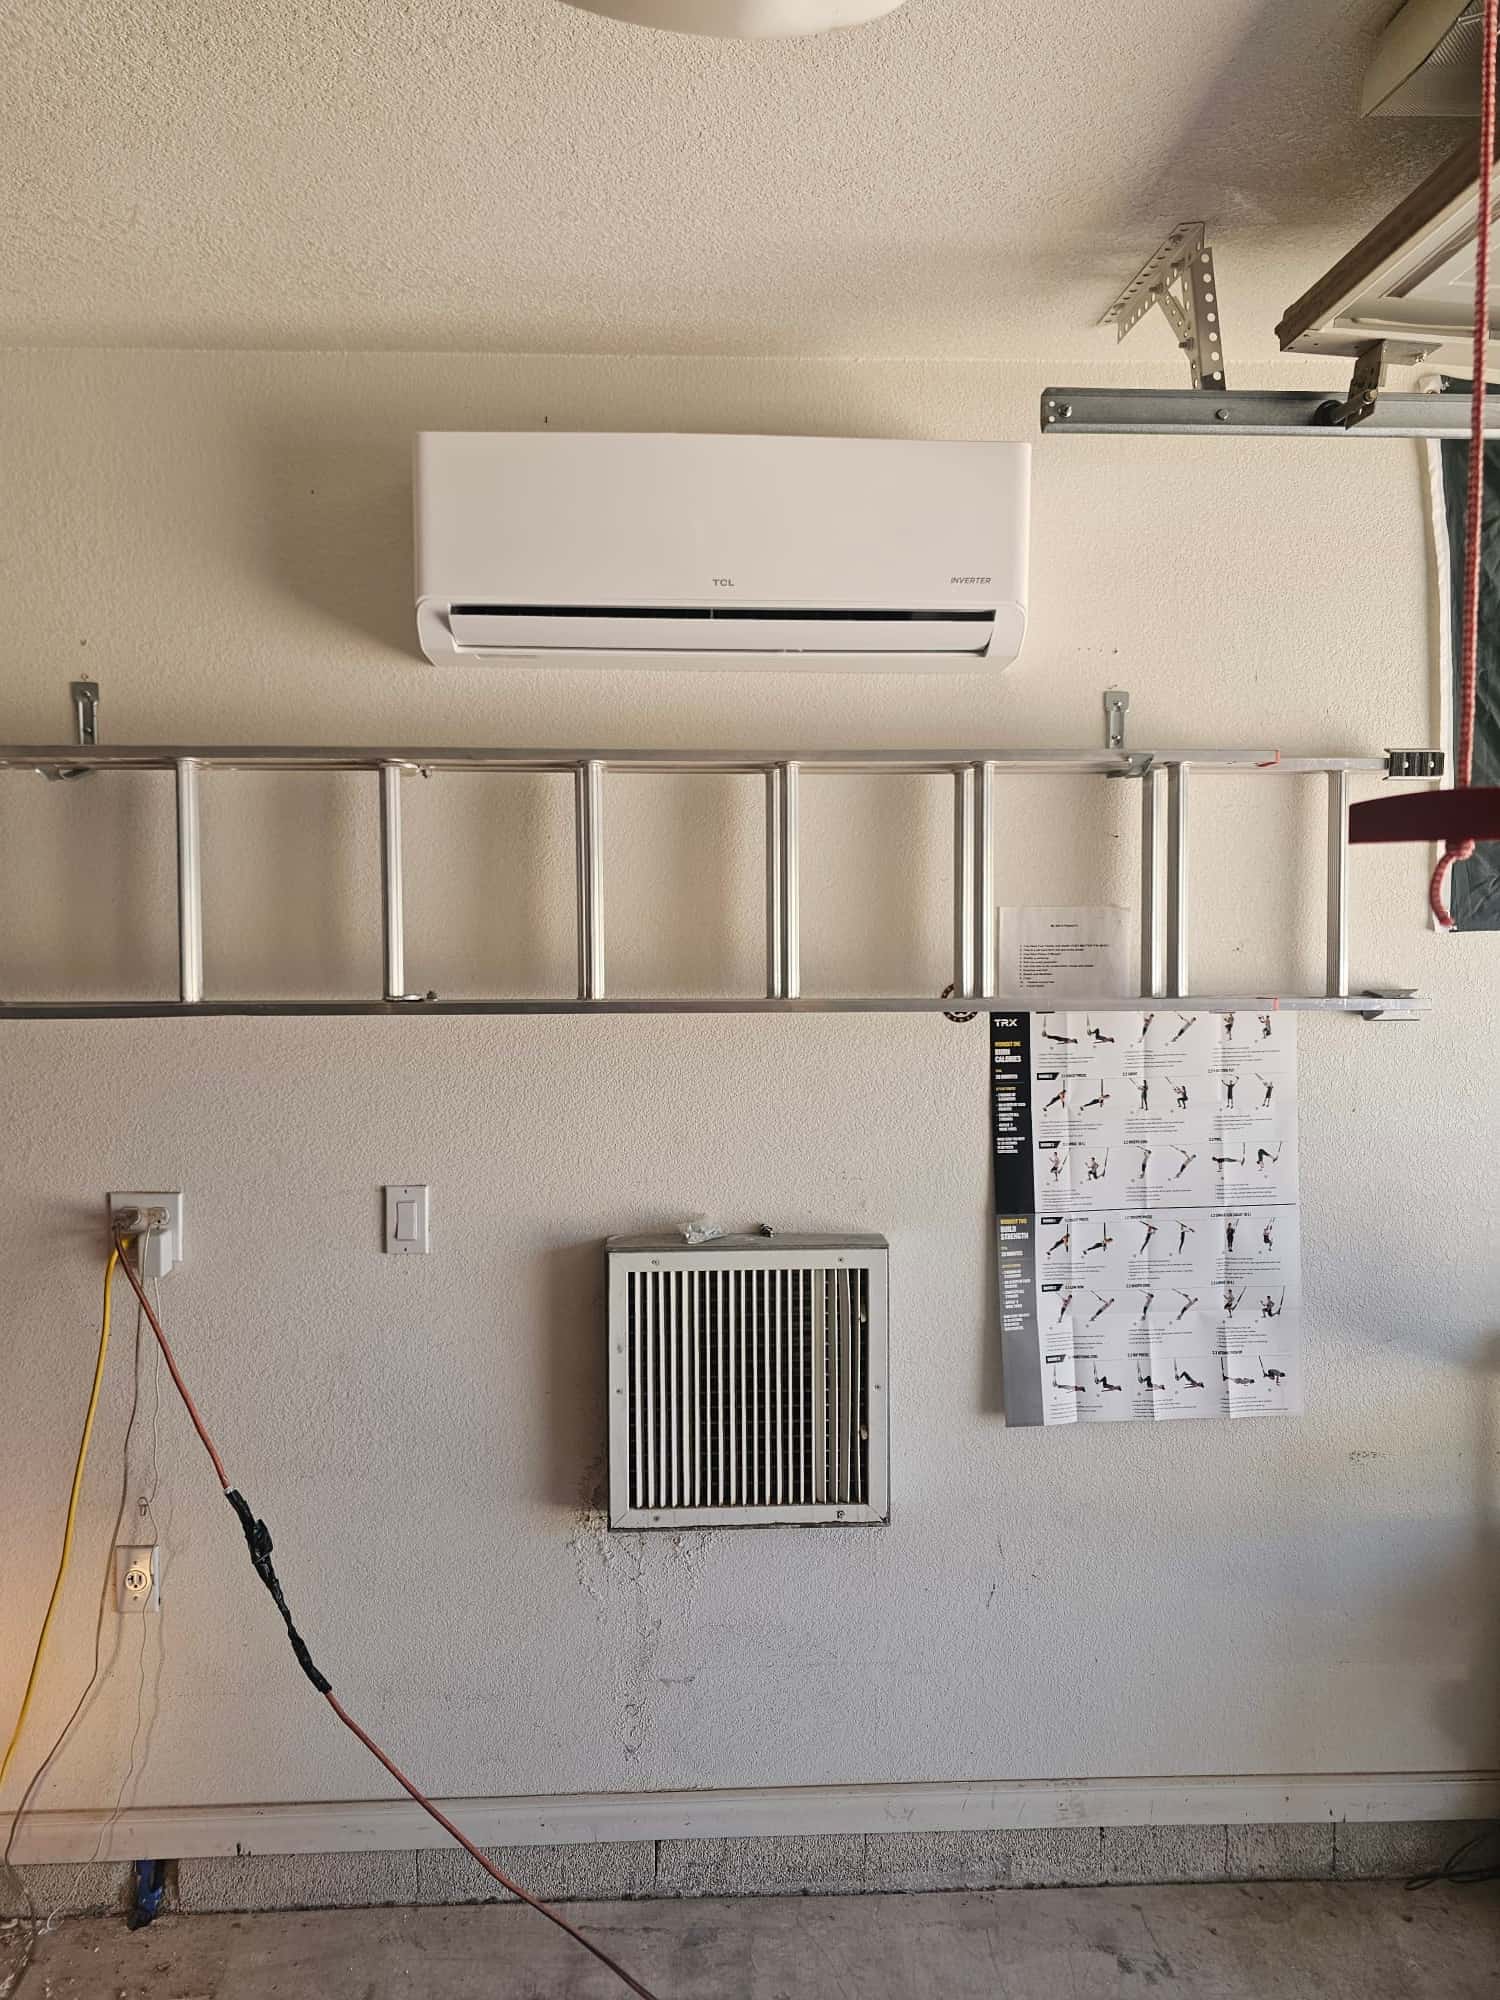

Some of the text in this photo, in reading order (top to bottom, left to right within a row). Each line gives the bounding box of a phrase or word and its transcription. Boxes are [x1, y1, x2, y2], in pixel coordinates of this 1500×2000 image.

[711, 578, 735, 587] TCL
[950, 577, 992, 585] INVERTER
[993, 1018, 1018, 1028] TRX
